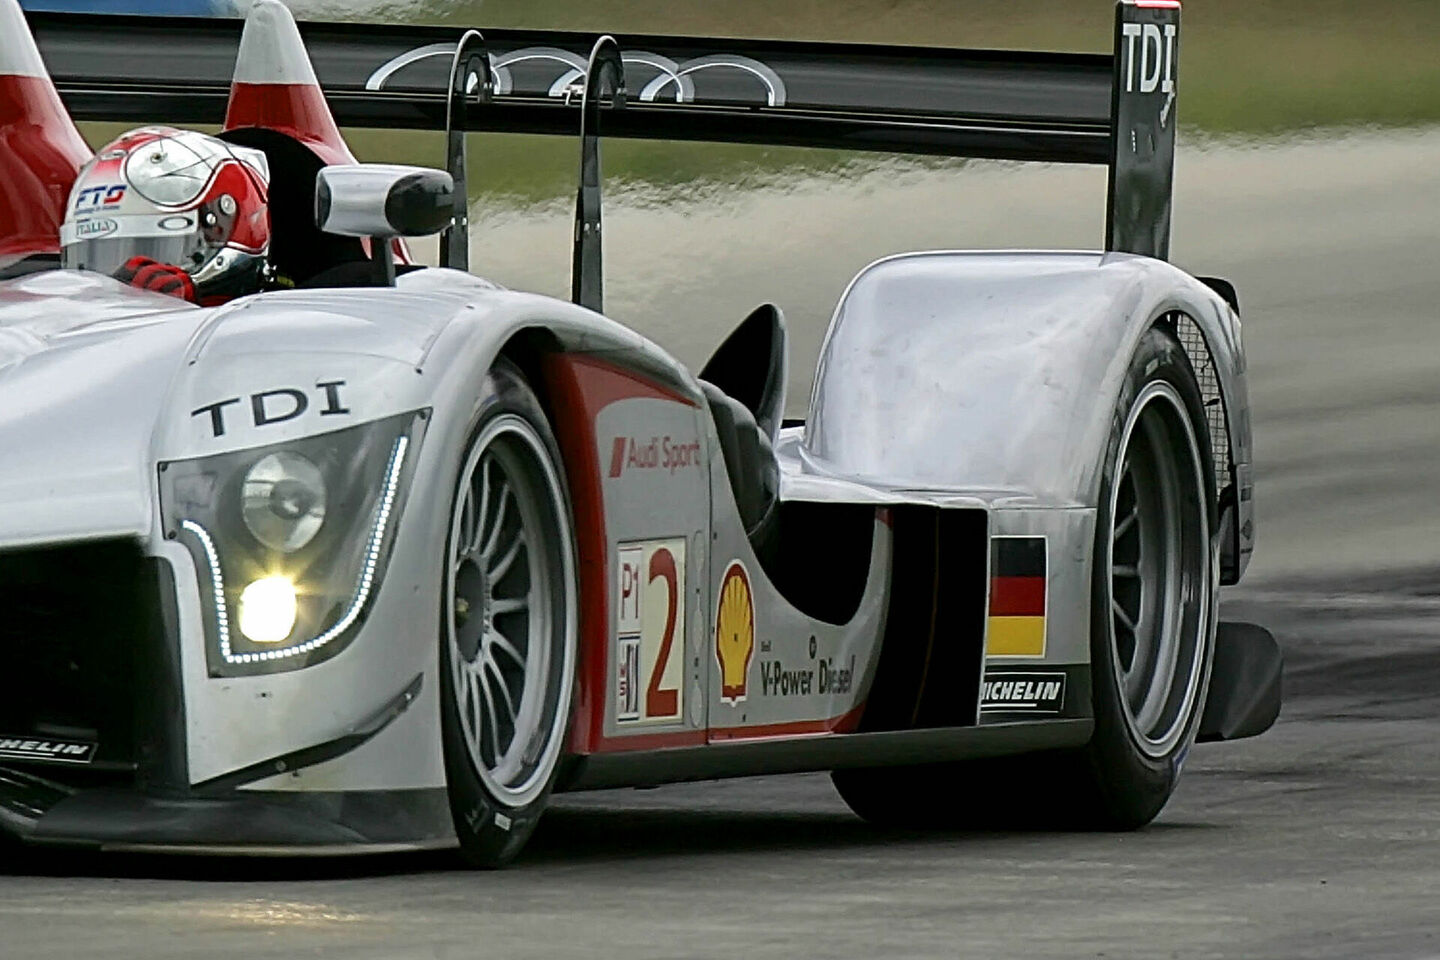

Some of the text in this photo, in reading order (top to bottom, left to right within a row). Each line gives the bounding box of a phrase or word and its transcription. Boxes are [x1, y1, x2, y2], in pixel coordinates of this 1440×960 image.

[1122, 23, 1176, 93] TDI
[191, 380, 350, 437] TDI
[626, 436, 700, 475] Audi Sport
[645, 547, 678, 718] 2
[760, 660, 813, 697] V-Power
